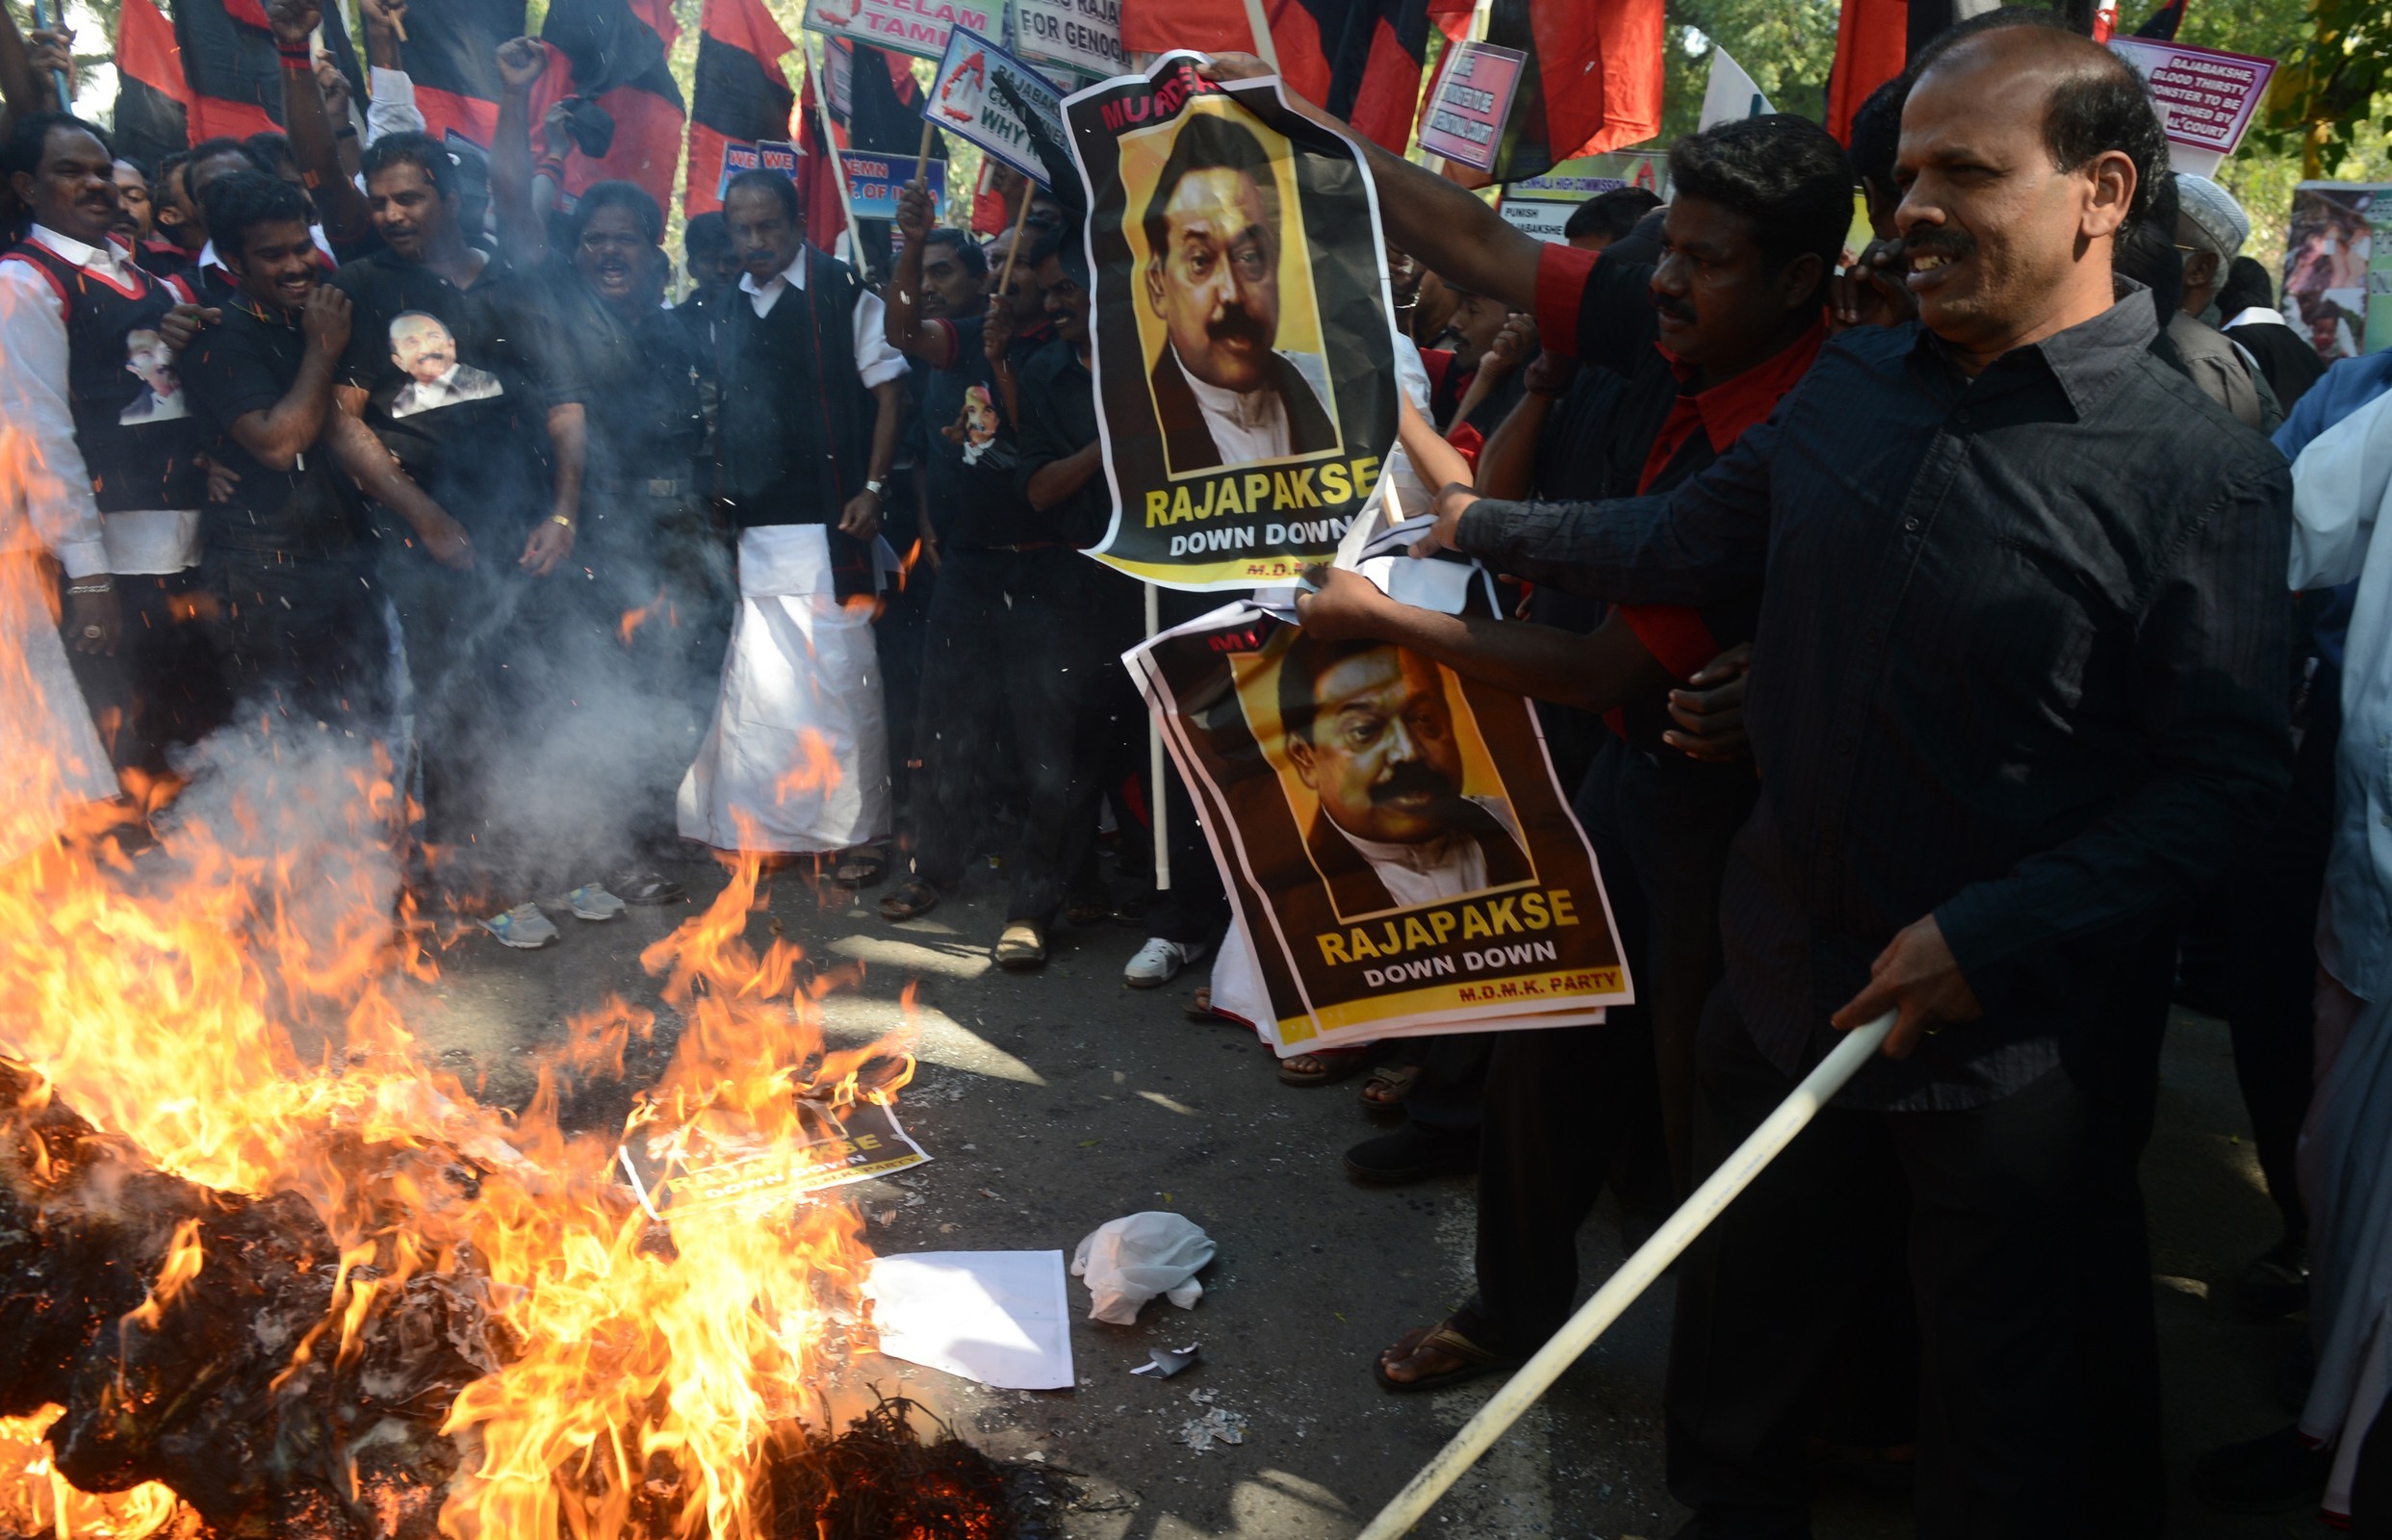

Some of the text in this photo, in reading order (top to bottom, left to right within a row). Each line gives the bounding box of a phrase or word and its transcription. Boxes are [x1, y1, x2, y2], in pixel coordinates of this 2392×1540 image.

[1020, 10, 1060, 39] FOR
[1078, 0, 1120, 27] RAJA
[864, 12, 948, 48] TAMI
[998, 64, 1061, 118] RAJABAK
[2151, 69, 2250, 96] BLOOD THIRSTY
[2169, 103, 2235, 124] NISHED BY
[2204, 93, 2222, 106] TO
[2223, 97, 2242, 111] BE
[981, 105, 1025, 145] WHY
[2182, 120, 2228, 139] COURT
[762, 150, 794, 170] WE
[864, 183, 887, 200] OF
[1505, 207, 1539, 219] PUNISH
[1145, 455, 1380, 528] RAJAPAKSE
[1170, 515, 1353, 557] DOWN DOWN
[1316, 888, 1580, 966] RAJAPAKSE
[1363, 939, 1557, 988] DOWN DOWN
[1458, 970, 1618, 1003] M.D.M.K. PARTY
[705, 1154, 867, 1200] DOWN DOWN
[862, 1156, 918, 1173] PARTY
